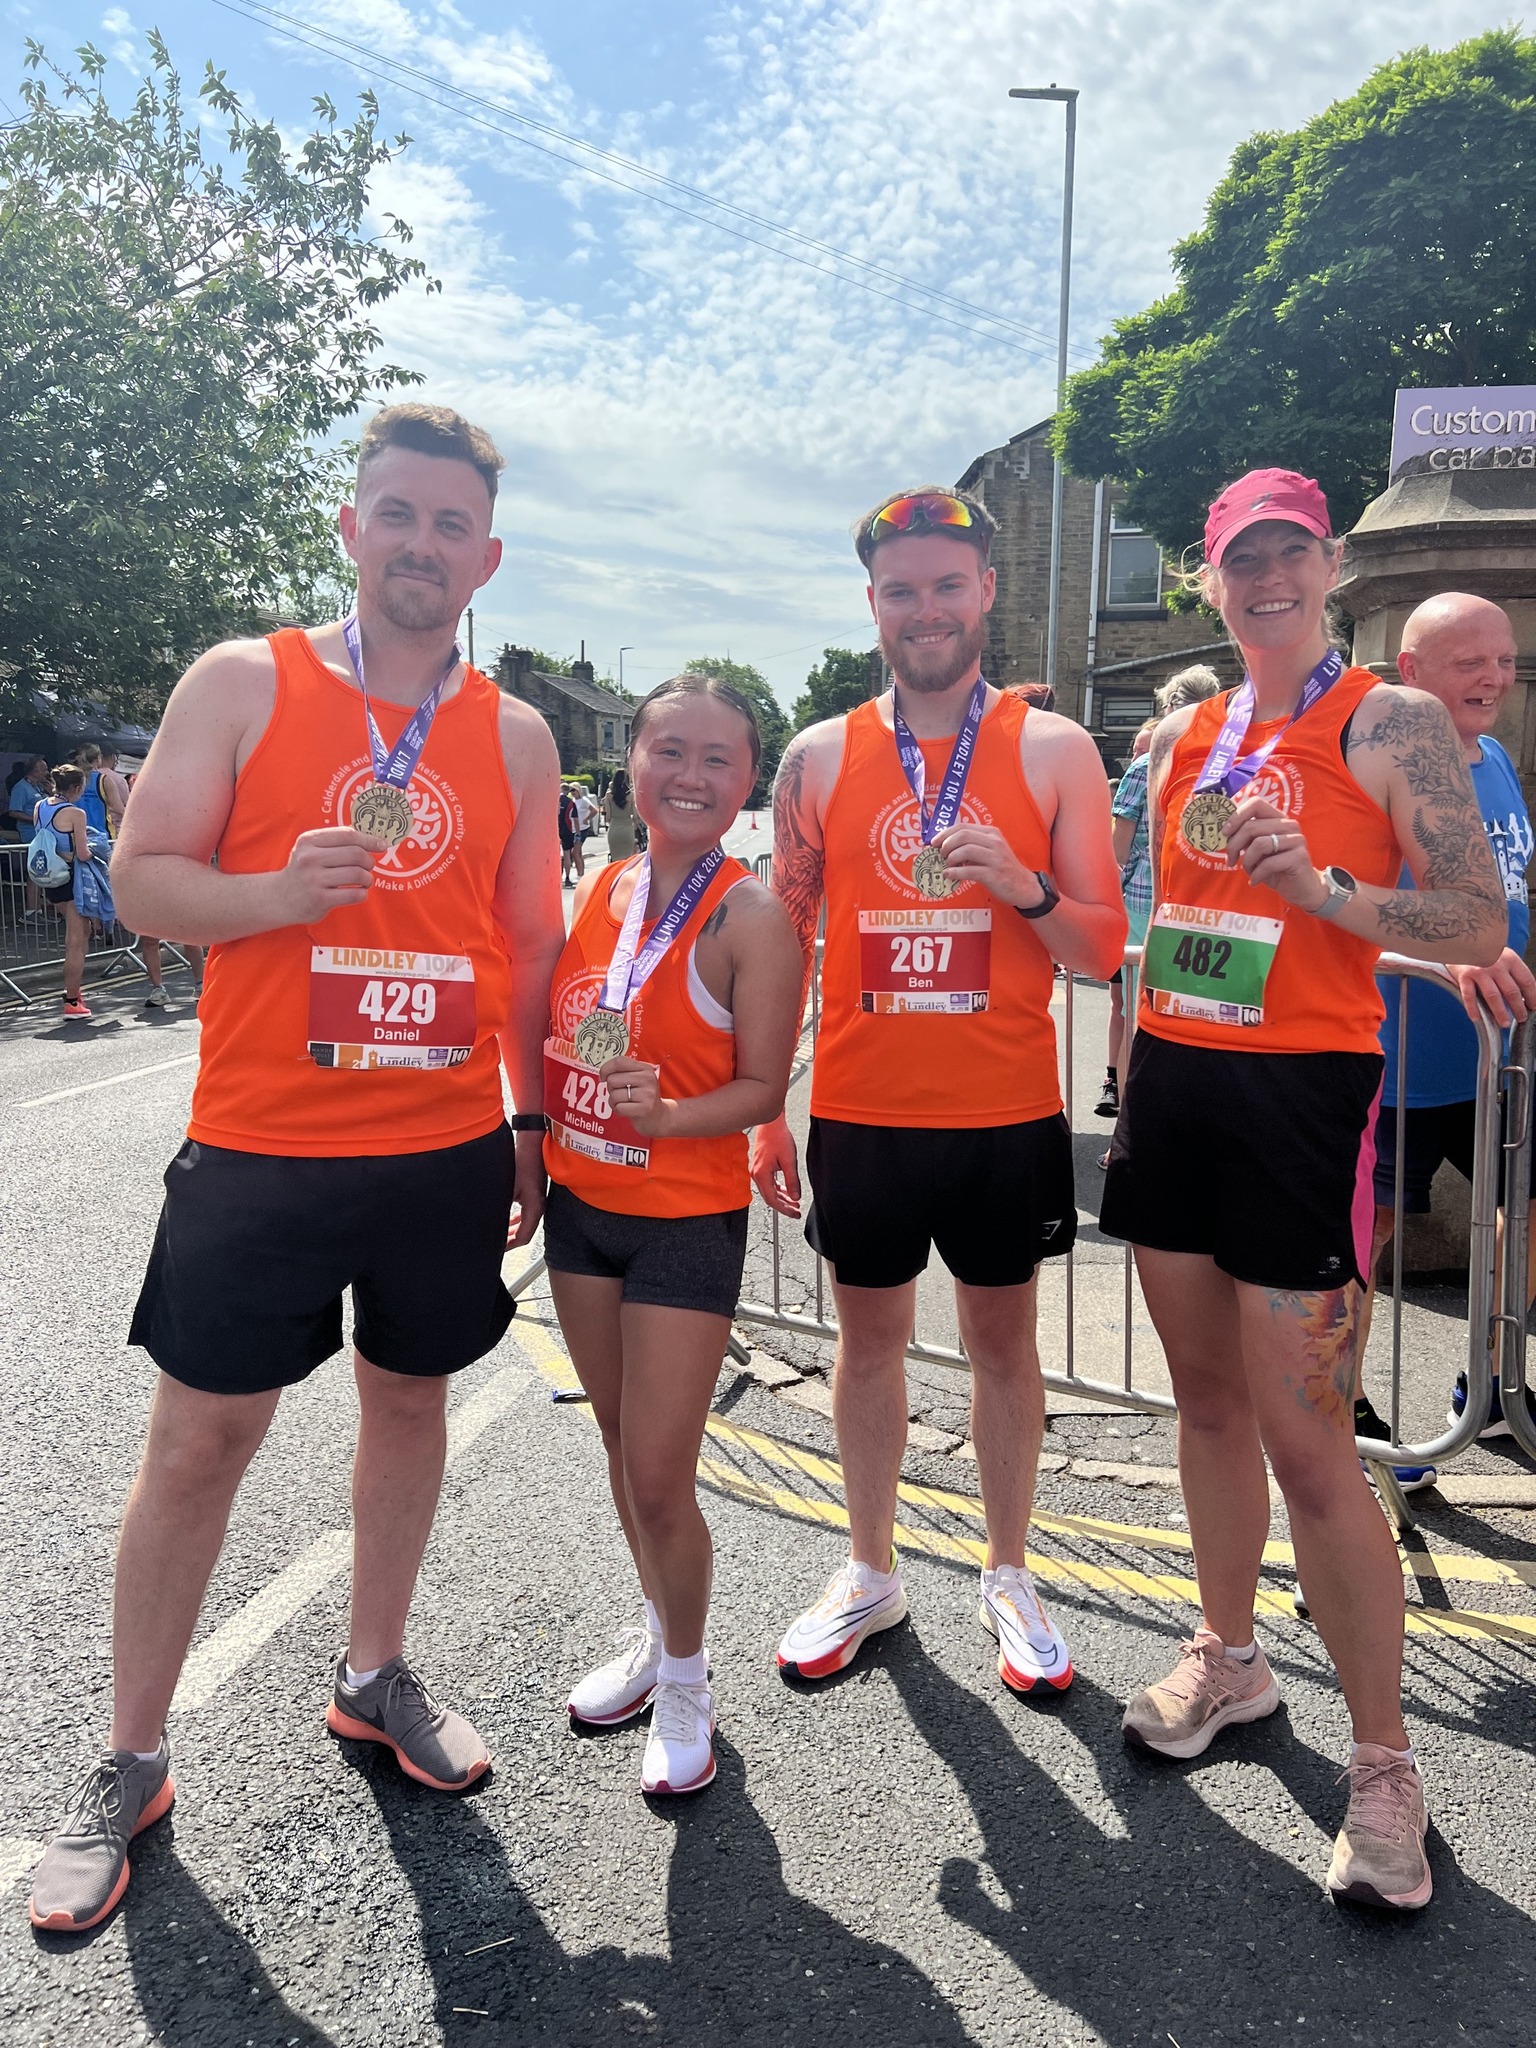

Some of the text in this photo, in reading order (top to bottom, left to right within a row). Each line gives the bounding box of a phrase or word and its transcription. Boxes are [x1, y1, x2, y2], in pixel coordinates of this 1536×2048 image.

[1411, 405, 1536, 435] Custom
[1429, 447, 1483, 469] car
[953, 727, 974, 778] LINDLEY
[321, 754, 370, 814] Calderdale and
[944, 780, 960, 802] 10K
[1285, 762, 1306, 816] NHS Charity
[439, 781, 466, 841] NHS Charity
[970, 796, 987, 813] NHS
[868, 790, 908, 848] Calderdale and
[374, 853, 456, 891] Make A Difference
[1198, 857, 1211, 869] We
[874, 860, 902, 893] Together
[902, 888, 917, 900] We
[655, 892, 692, 943] LINDLEY
[688, 872, 706, 893] 10K
[868, 910, 975, 926] LINDLEY 10K
[1227, 913, 1262, 933] 10K
[332, 949, 457, 973] LINDLEY 10K
[890, 936, 953, 973] 267
[1172, 935, 1232, 980] 482
[908, 977, 933, 988] Ben
[358, 980, 436, 1025] 429
[907, 1001, 947, 1013] Lindley
[1180, 1004, 1215, 1021] Lindley
[373, 1027, 420, 1041] Daniel
[632, 1004, 644, 1040] Charity
[379, 1056, 423, 1067] Lindley
[562, 1070, 613, 1120] 428
[565, 1111, 605, 1135] Michelle
[571, 1139, 602, 1158] Lindley
